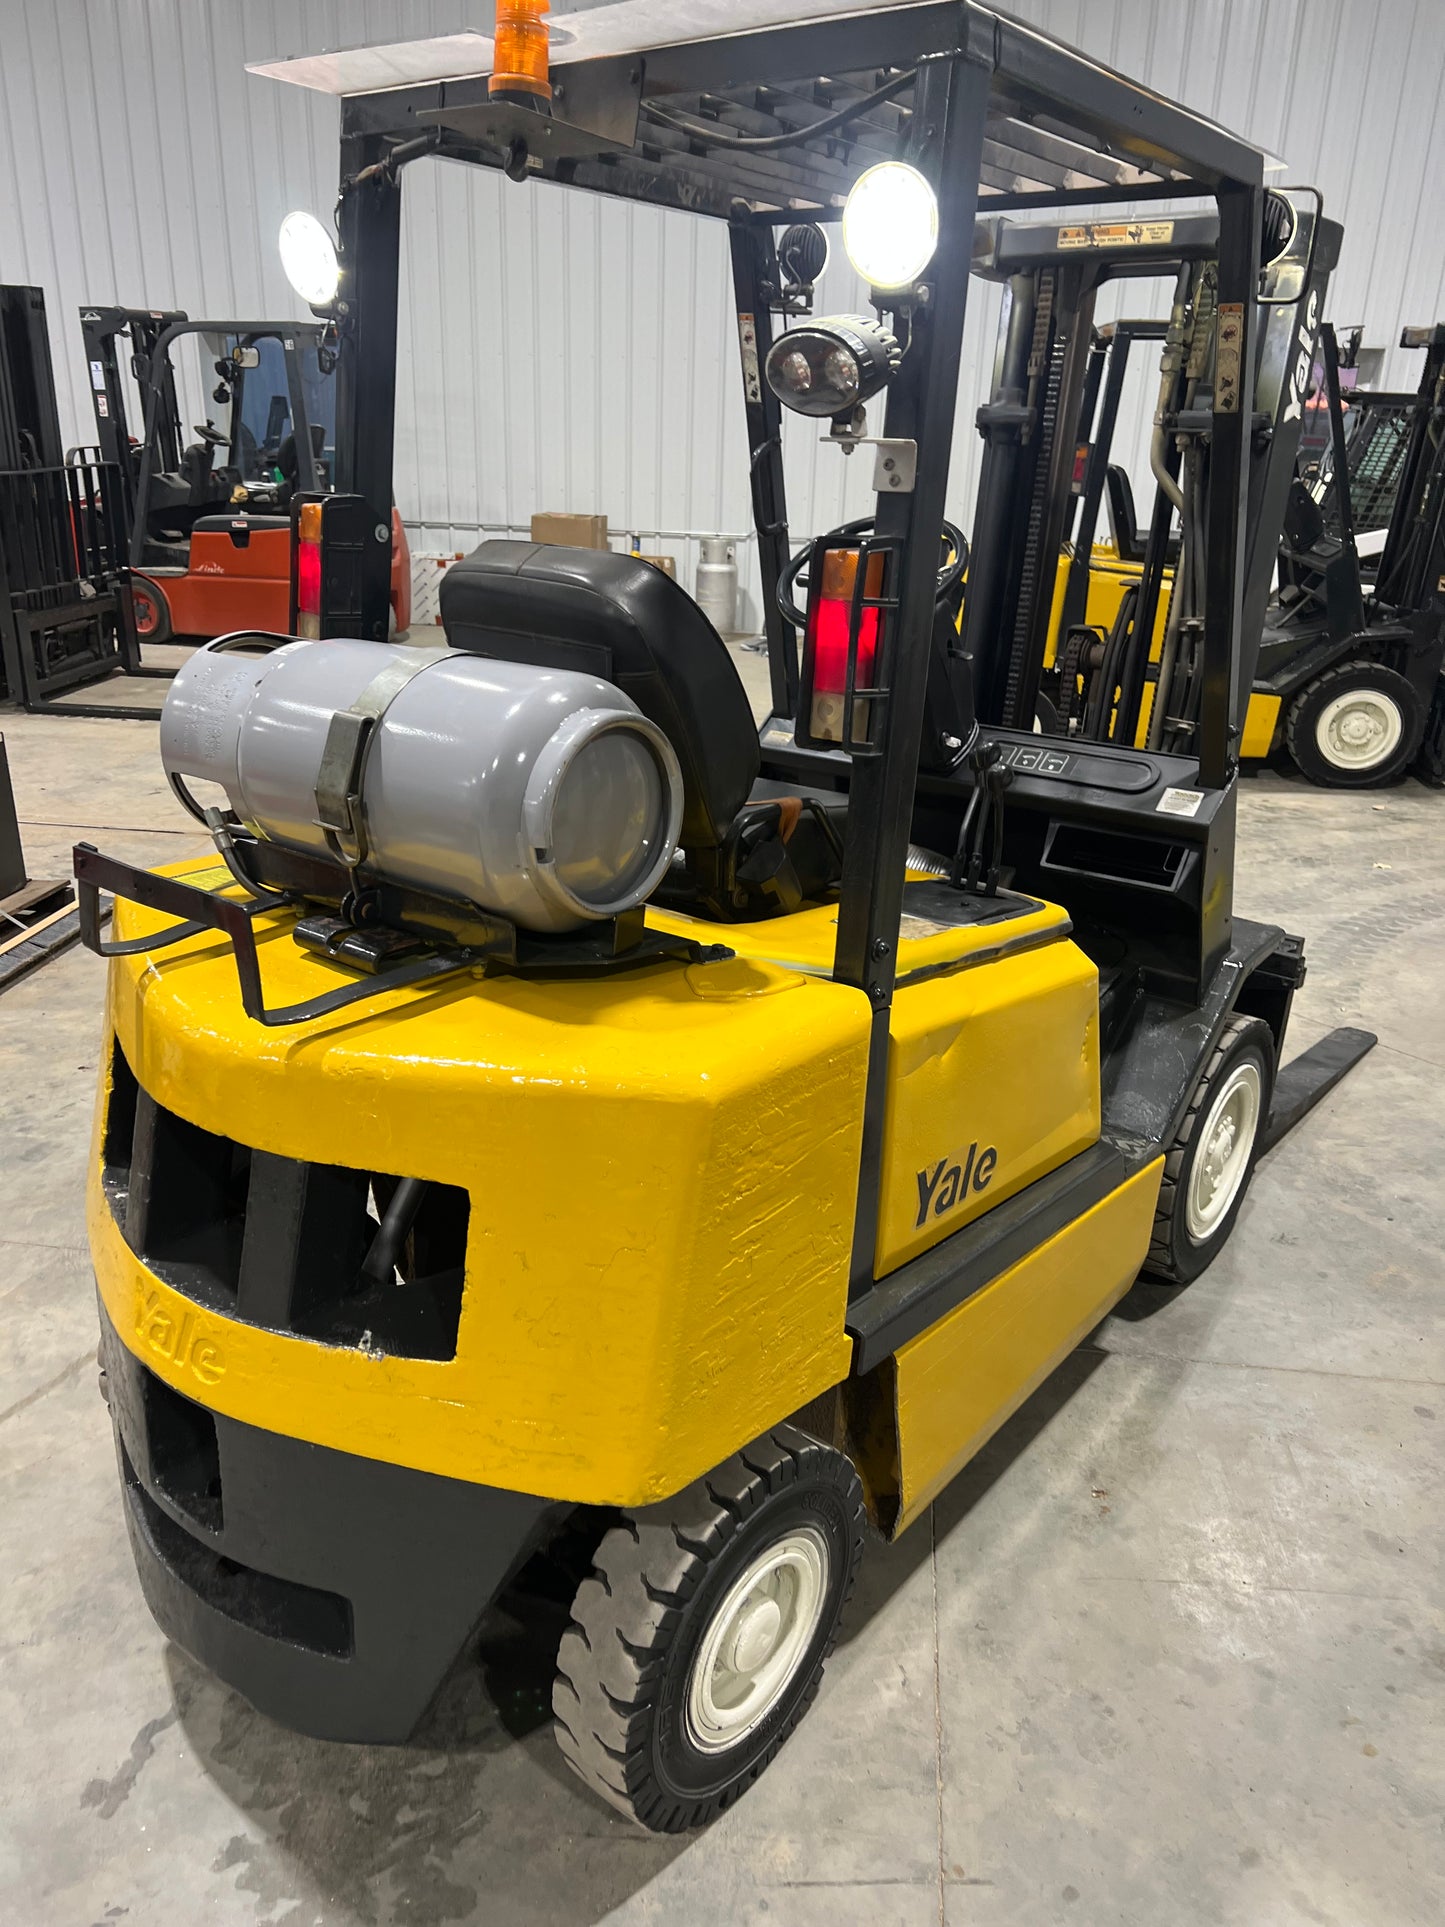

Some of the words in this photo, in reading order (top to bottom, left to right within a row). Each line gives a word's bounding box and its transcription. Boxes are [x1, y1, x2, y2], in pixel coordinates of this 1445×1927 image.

[1283, 290, 1317, 423] Yale
[916, 1141, 997, 1227] Yale
[134, 1275, 227, 1385] Yale
